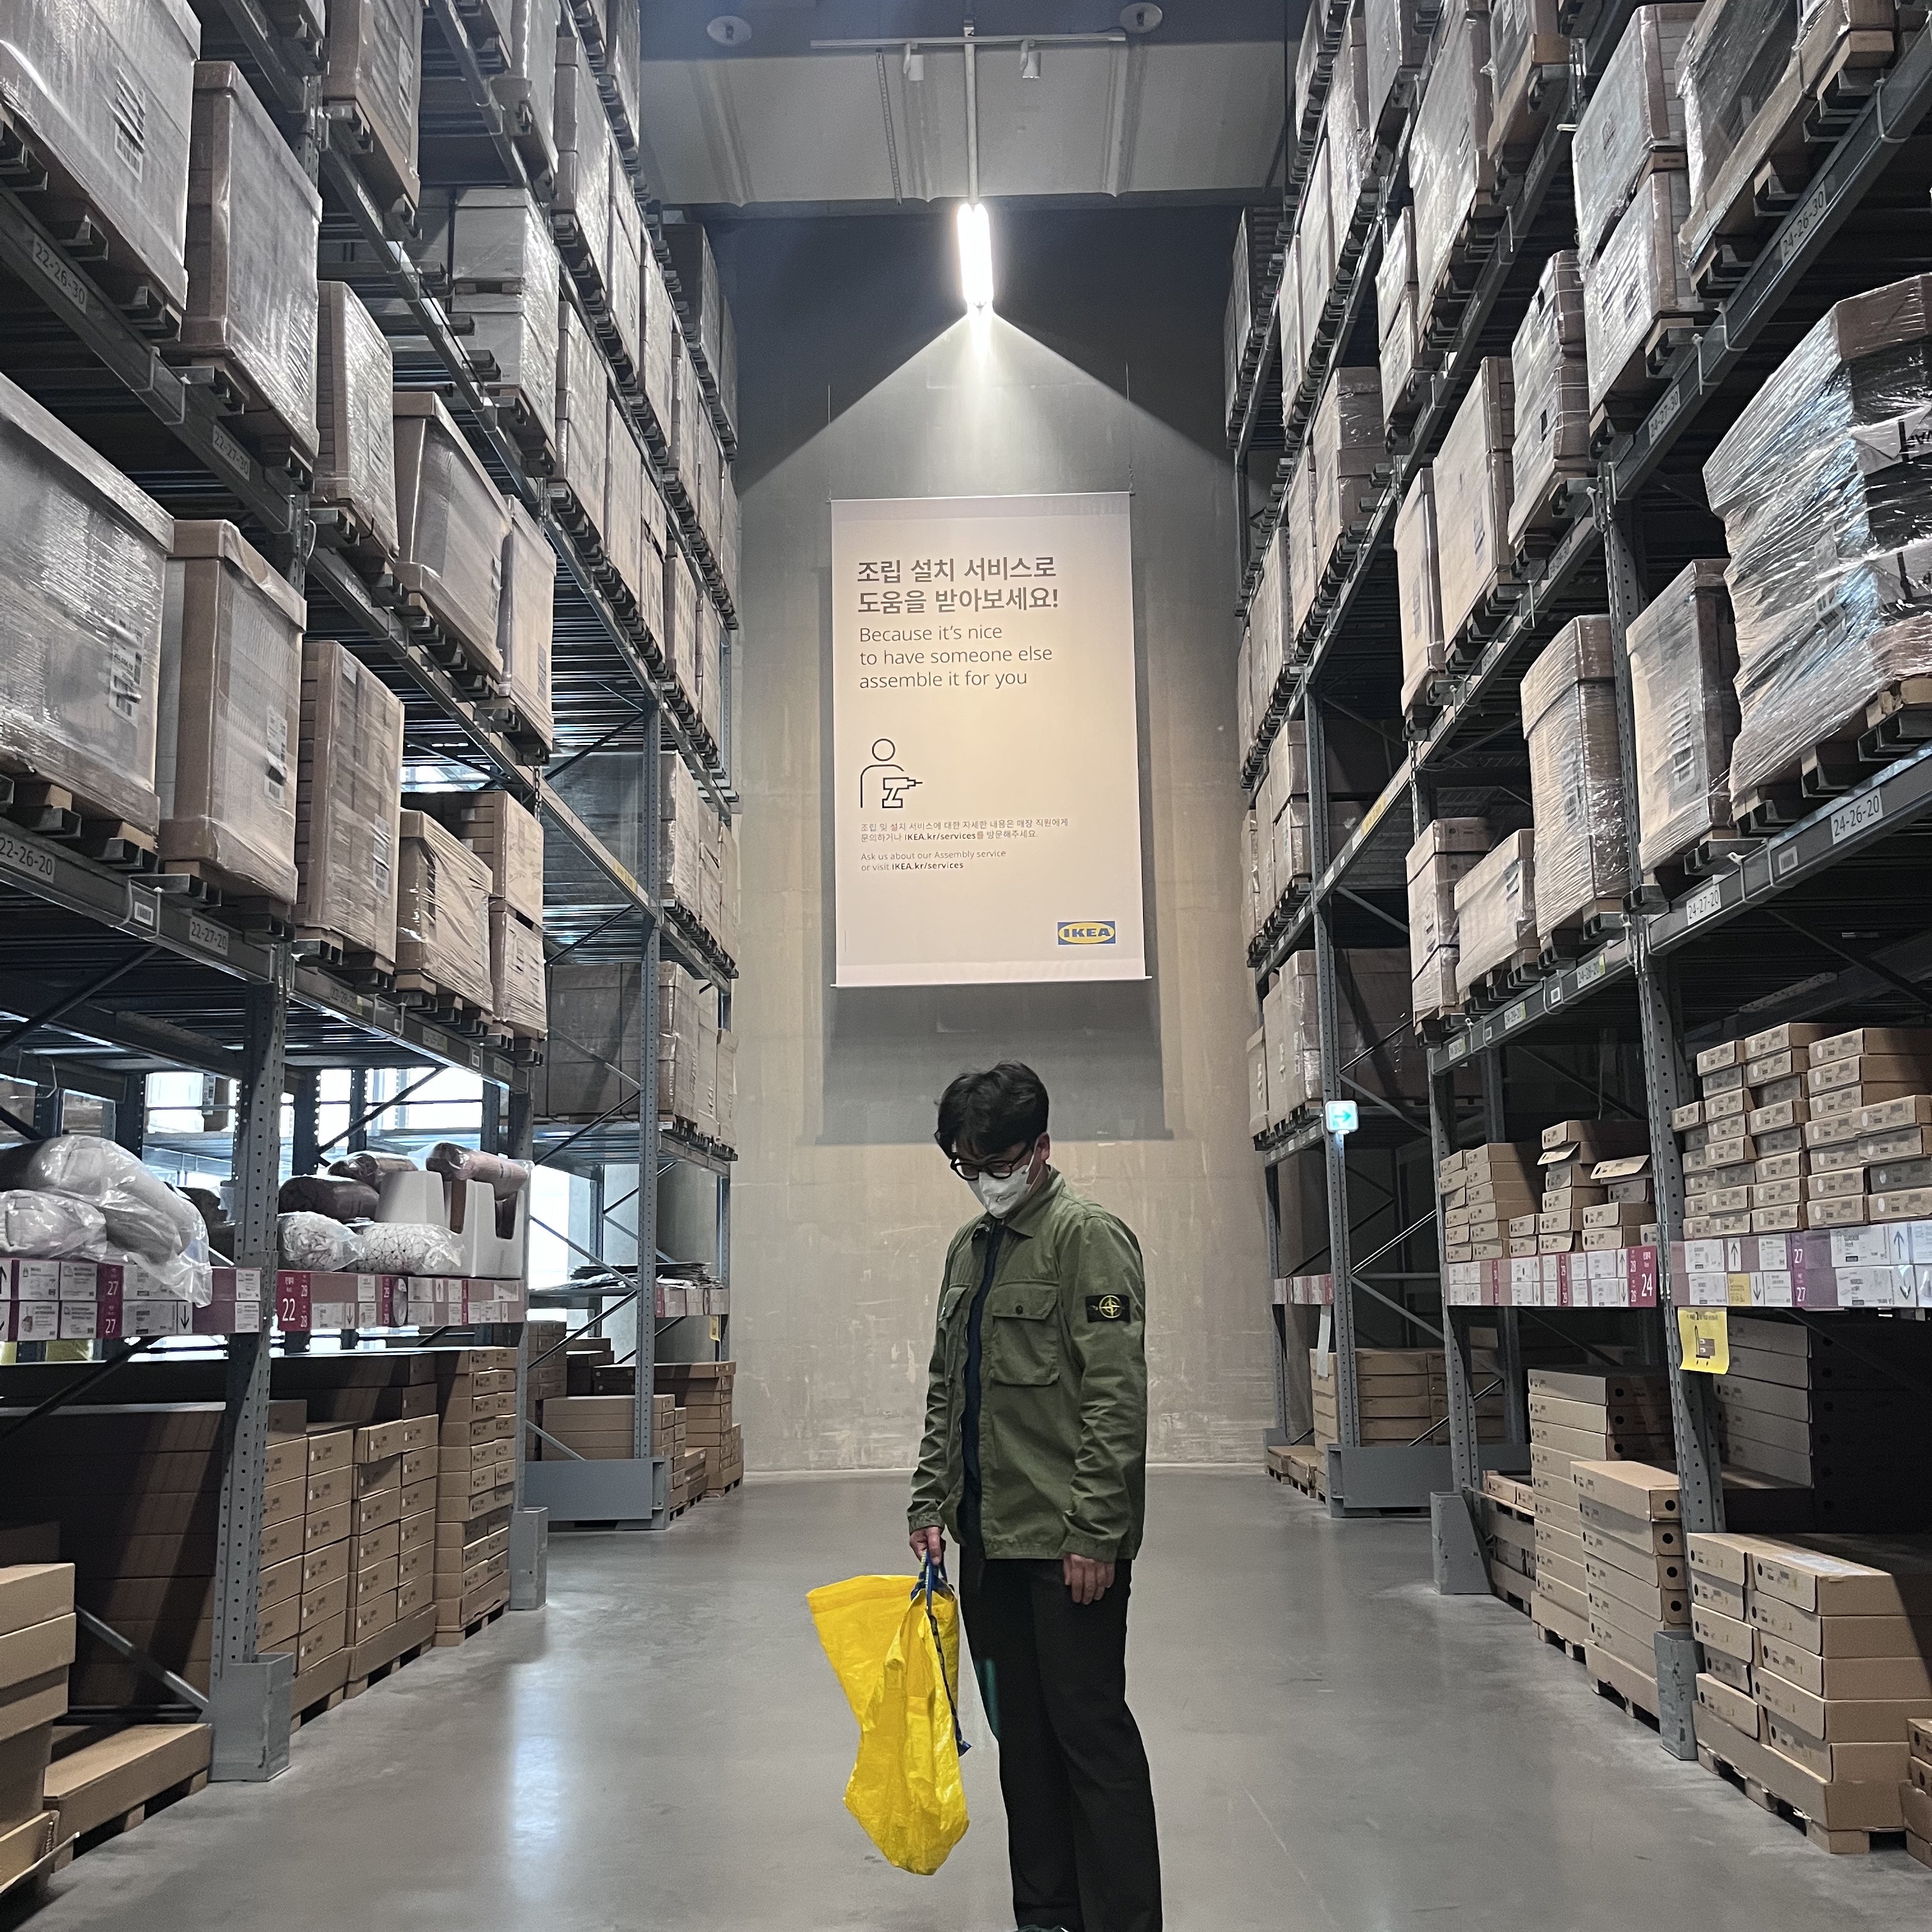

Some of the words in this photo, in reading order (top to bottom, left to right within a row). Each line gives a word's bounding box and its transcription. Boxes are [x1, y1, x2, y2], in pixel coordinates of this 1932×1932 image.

[1783, 190, 1824, 257] 24-26-30
[35, 241, 85, 305] 22-26-30
[214, 430, 249, 475] 22-27-30
[857, 559, 901, 584] 조립
[910, 558, 954, 583] 설치
[963, 556, 1057, 581] 서비스로
[857, 589, 927, 615] 도움을
[935, 586, 1059, 613] 받아보세요!
[860, 627, 932, 643] Because
[968, 624, 1002, 640] nice
[860, 652, 877, 665] to
[884, 650, 924, 664] have
[930, 650, 1012, 664] someone
[1018, 646, 1053, 661] else
[859, 671, 942, 689] assemble
[948, 671, 960, 686] it
[965, 670, 990, 686] for
[995, 671, 1027, 689] you
[861, 823, 877, 832] 조립
[879, 822, 887, 832] 및
[890, 822, 906, 832] 설치
[908, 821, 941, 831] 서비스에
[944, 821, 960, 830] 대한
[962, 820, 987, 829] 자세한
[990, 819, 1015, 829] 내용은
[1016, 818, 1032, 828] 매장
[1035, 818, 1068, 827] 직원에게
[1833, 795, 1880, 838] 24-26-20
[861, 833, 901, 843] 문의하거나
[0, 837, 53, 876] 22-26-20
[934, 850, 975, 860] Assembly
[976, 850, 1006, 858] service
[892, 862, 964, 870] IKEA.kr/services
[1688, 889, 1719, 919] 24-27-20
[191, 921, 228, 950] 22-27-20
[1063, 928, 1111, 938] IKEA
[1794, 1248, 1803, 1264] 27
[107, 1280, 119, 1296] 27
[1641, 1273, 1653, 1297] 24
[1797, 1287, 1806, 1302] 27
[282, 1298, 296, 1322] 22
[105, 1318, 116, 1334] 27
